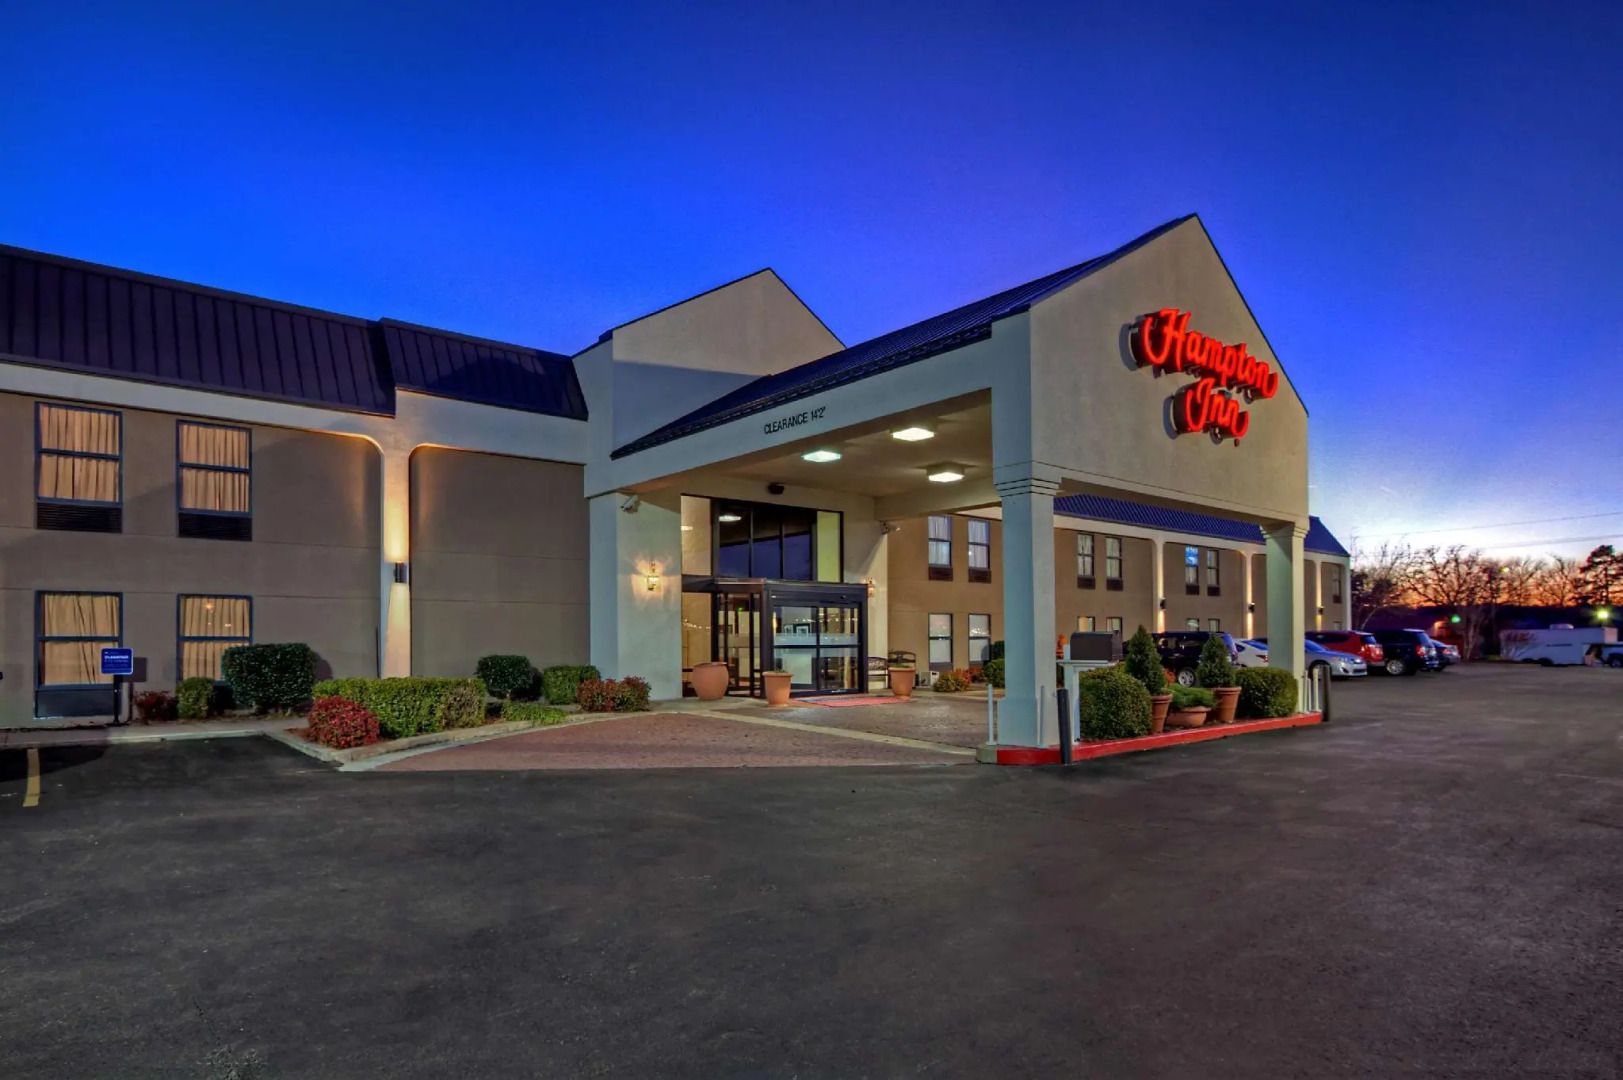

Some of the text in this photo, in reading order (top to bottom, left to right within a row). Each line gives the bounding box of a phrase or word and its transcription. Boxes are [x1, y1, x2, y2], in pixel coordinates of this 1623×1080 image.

[1138, 308, 1279, 399] Hampton
[764, 412, 809, 435] CLEARANCE
[1182, 377, 1250, 438] Inn
